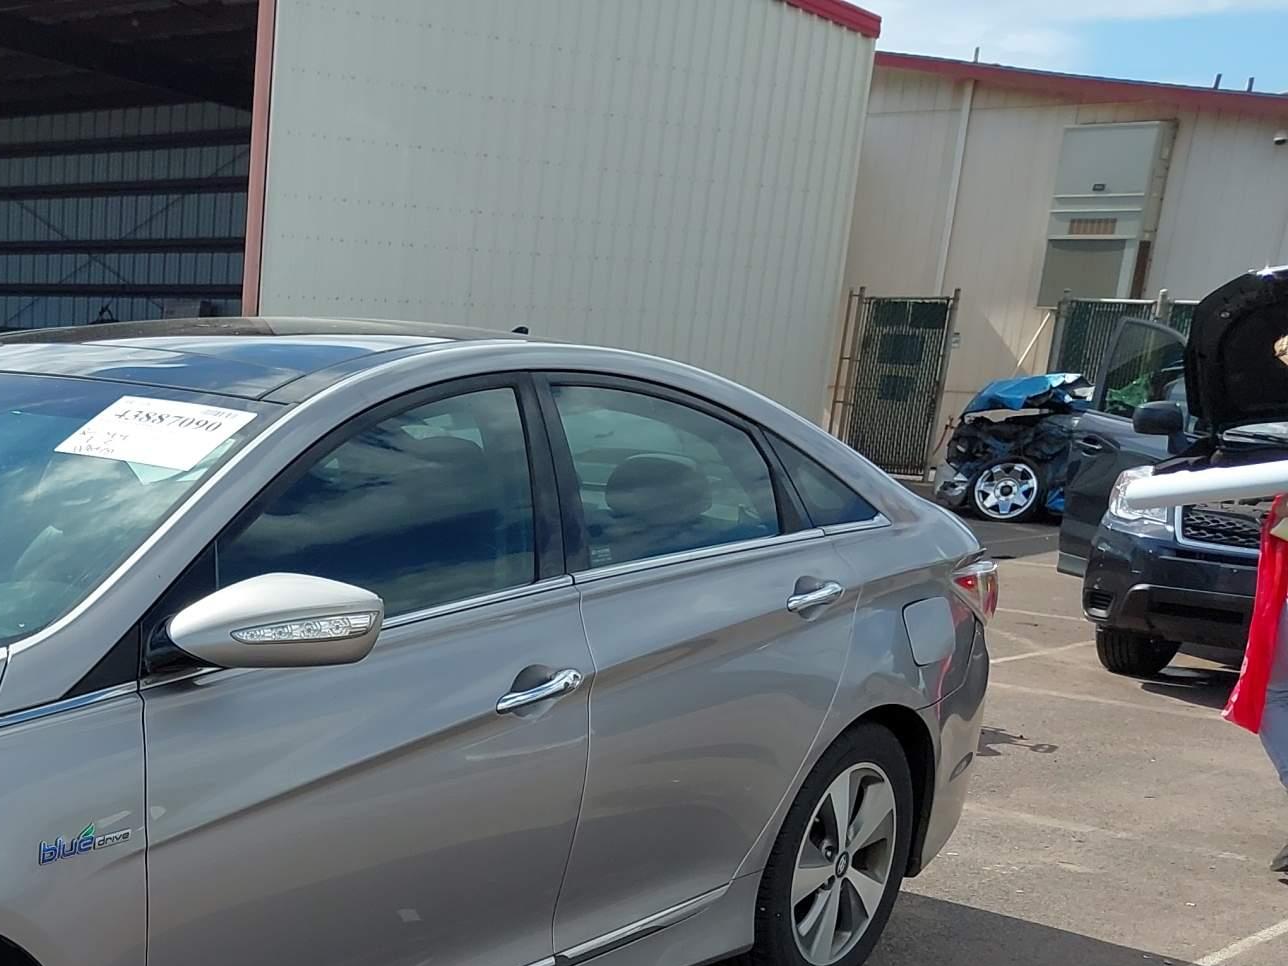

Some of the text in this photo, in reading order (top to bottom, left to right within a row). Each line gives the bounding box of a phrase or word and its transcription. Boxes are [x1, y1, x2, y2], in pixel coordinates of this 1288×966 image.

[115, 408, 223, 433] 43887090
[38, 827, 130, 865] blue drive
